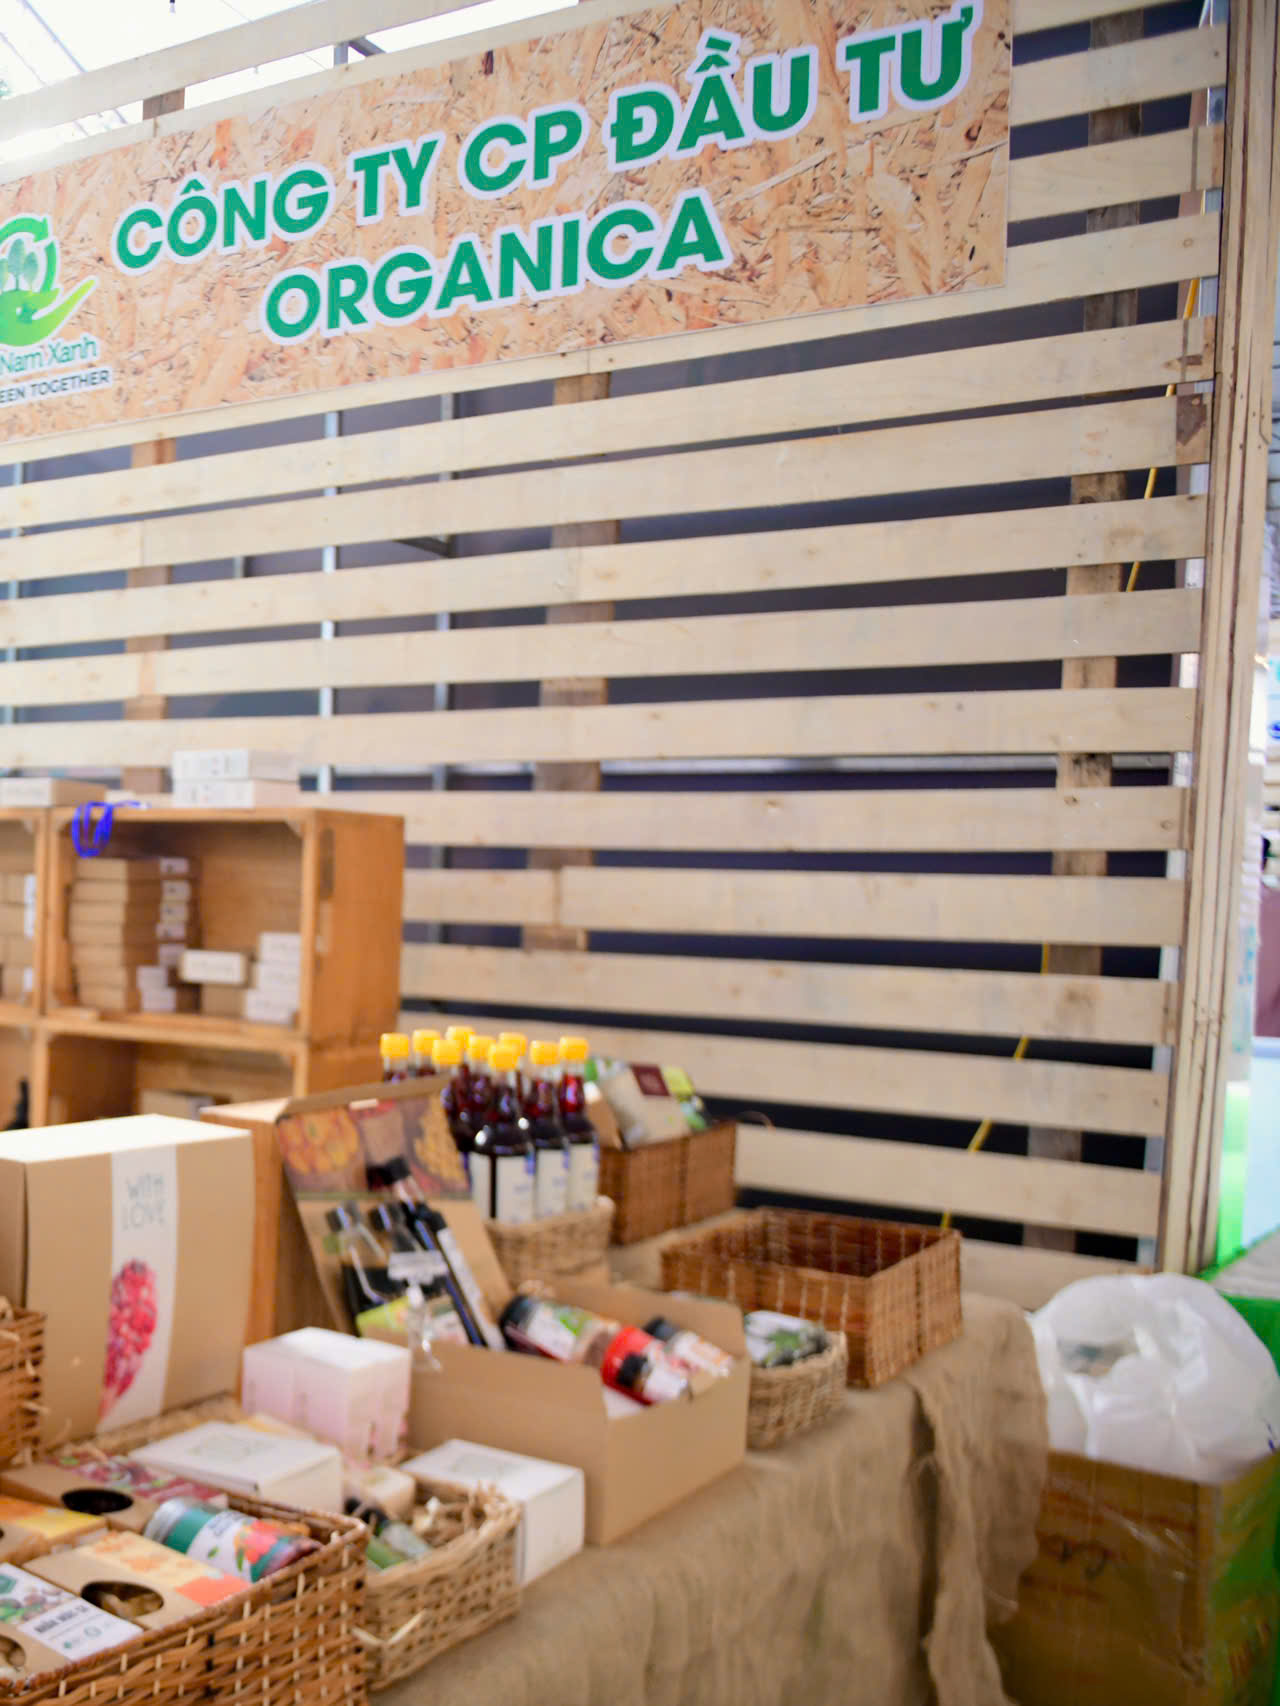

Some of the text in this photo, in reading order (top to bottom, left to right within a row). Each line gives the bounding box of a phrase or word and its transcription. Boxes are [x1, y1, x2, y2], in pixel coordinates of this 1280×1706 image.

[117, 5, 974, 269] CÔNG TY CP ĐẦU TƯ
[266, 196, 724, 338] ORGANICA
[0, 350, 43, 376] Nam
[47, 336, 98, 365] Xanh
[31, 369, 110, 396] TOGETHER
